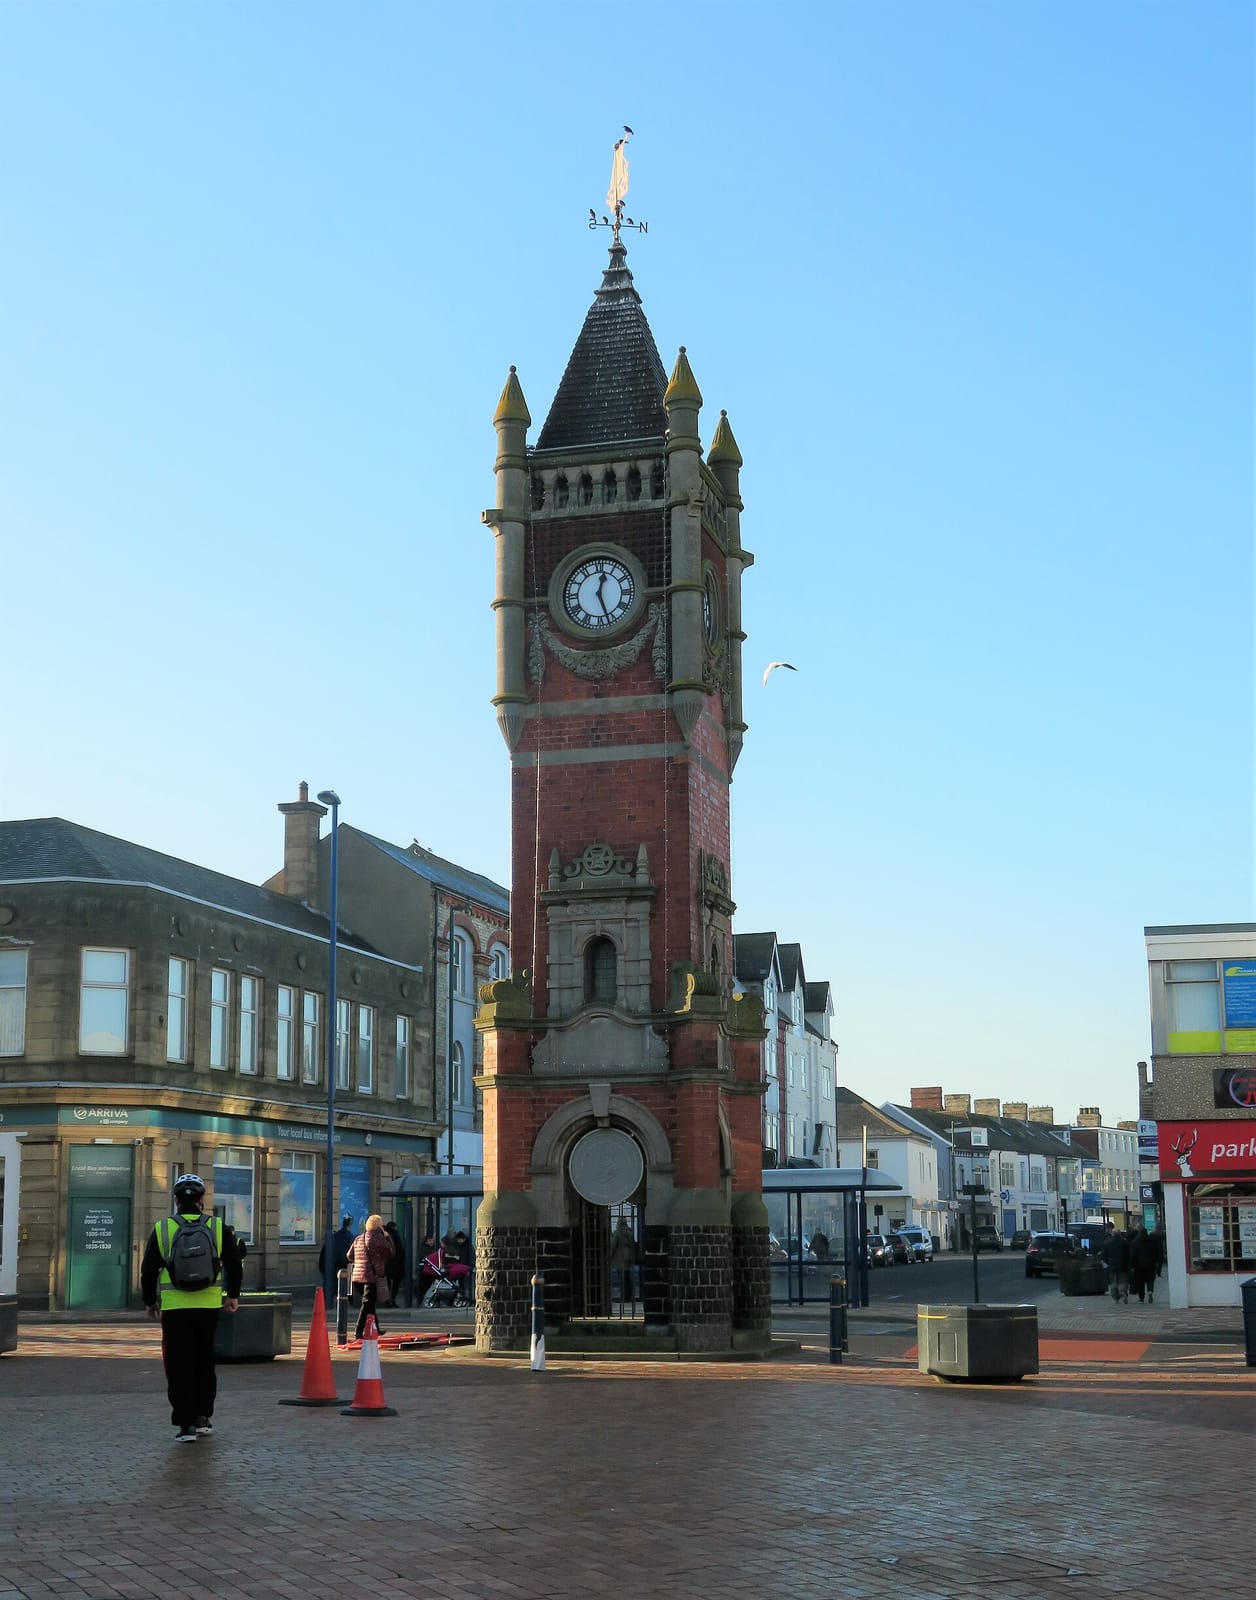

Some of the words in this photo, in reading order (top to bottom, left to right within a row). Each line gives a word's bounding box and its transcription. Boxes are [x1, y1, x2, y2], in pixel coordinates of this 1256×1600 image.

[639, 221, 648, 233] N
[88, 1108, 128, 1118] ARRIVA
[277, 1125, 290, 1137] Your
[290, 1127, 303, 1139] local
[303, 1128, 313, 1140] bus
